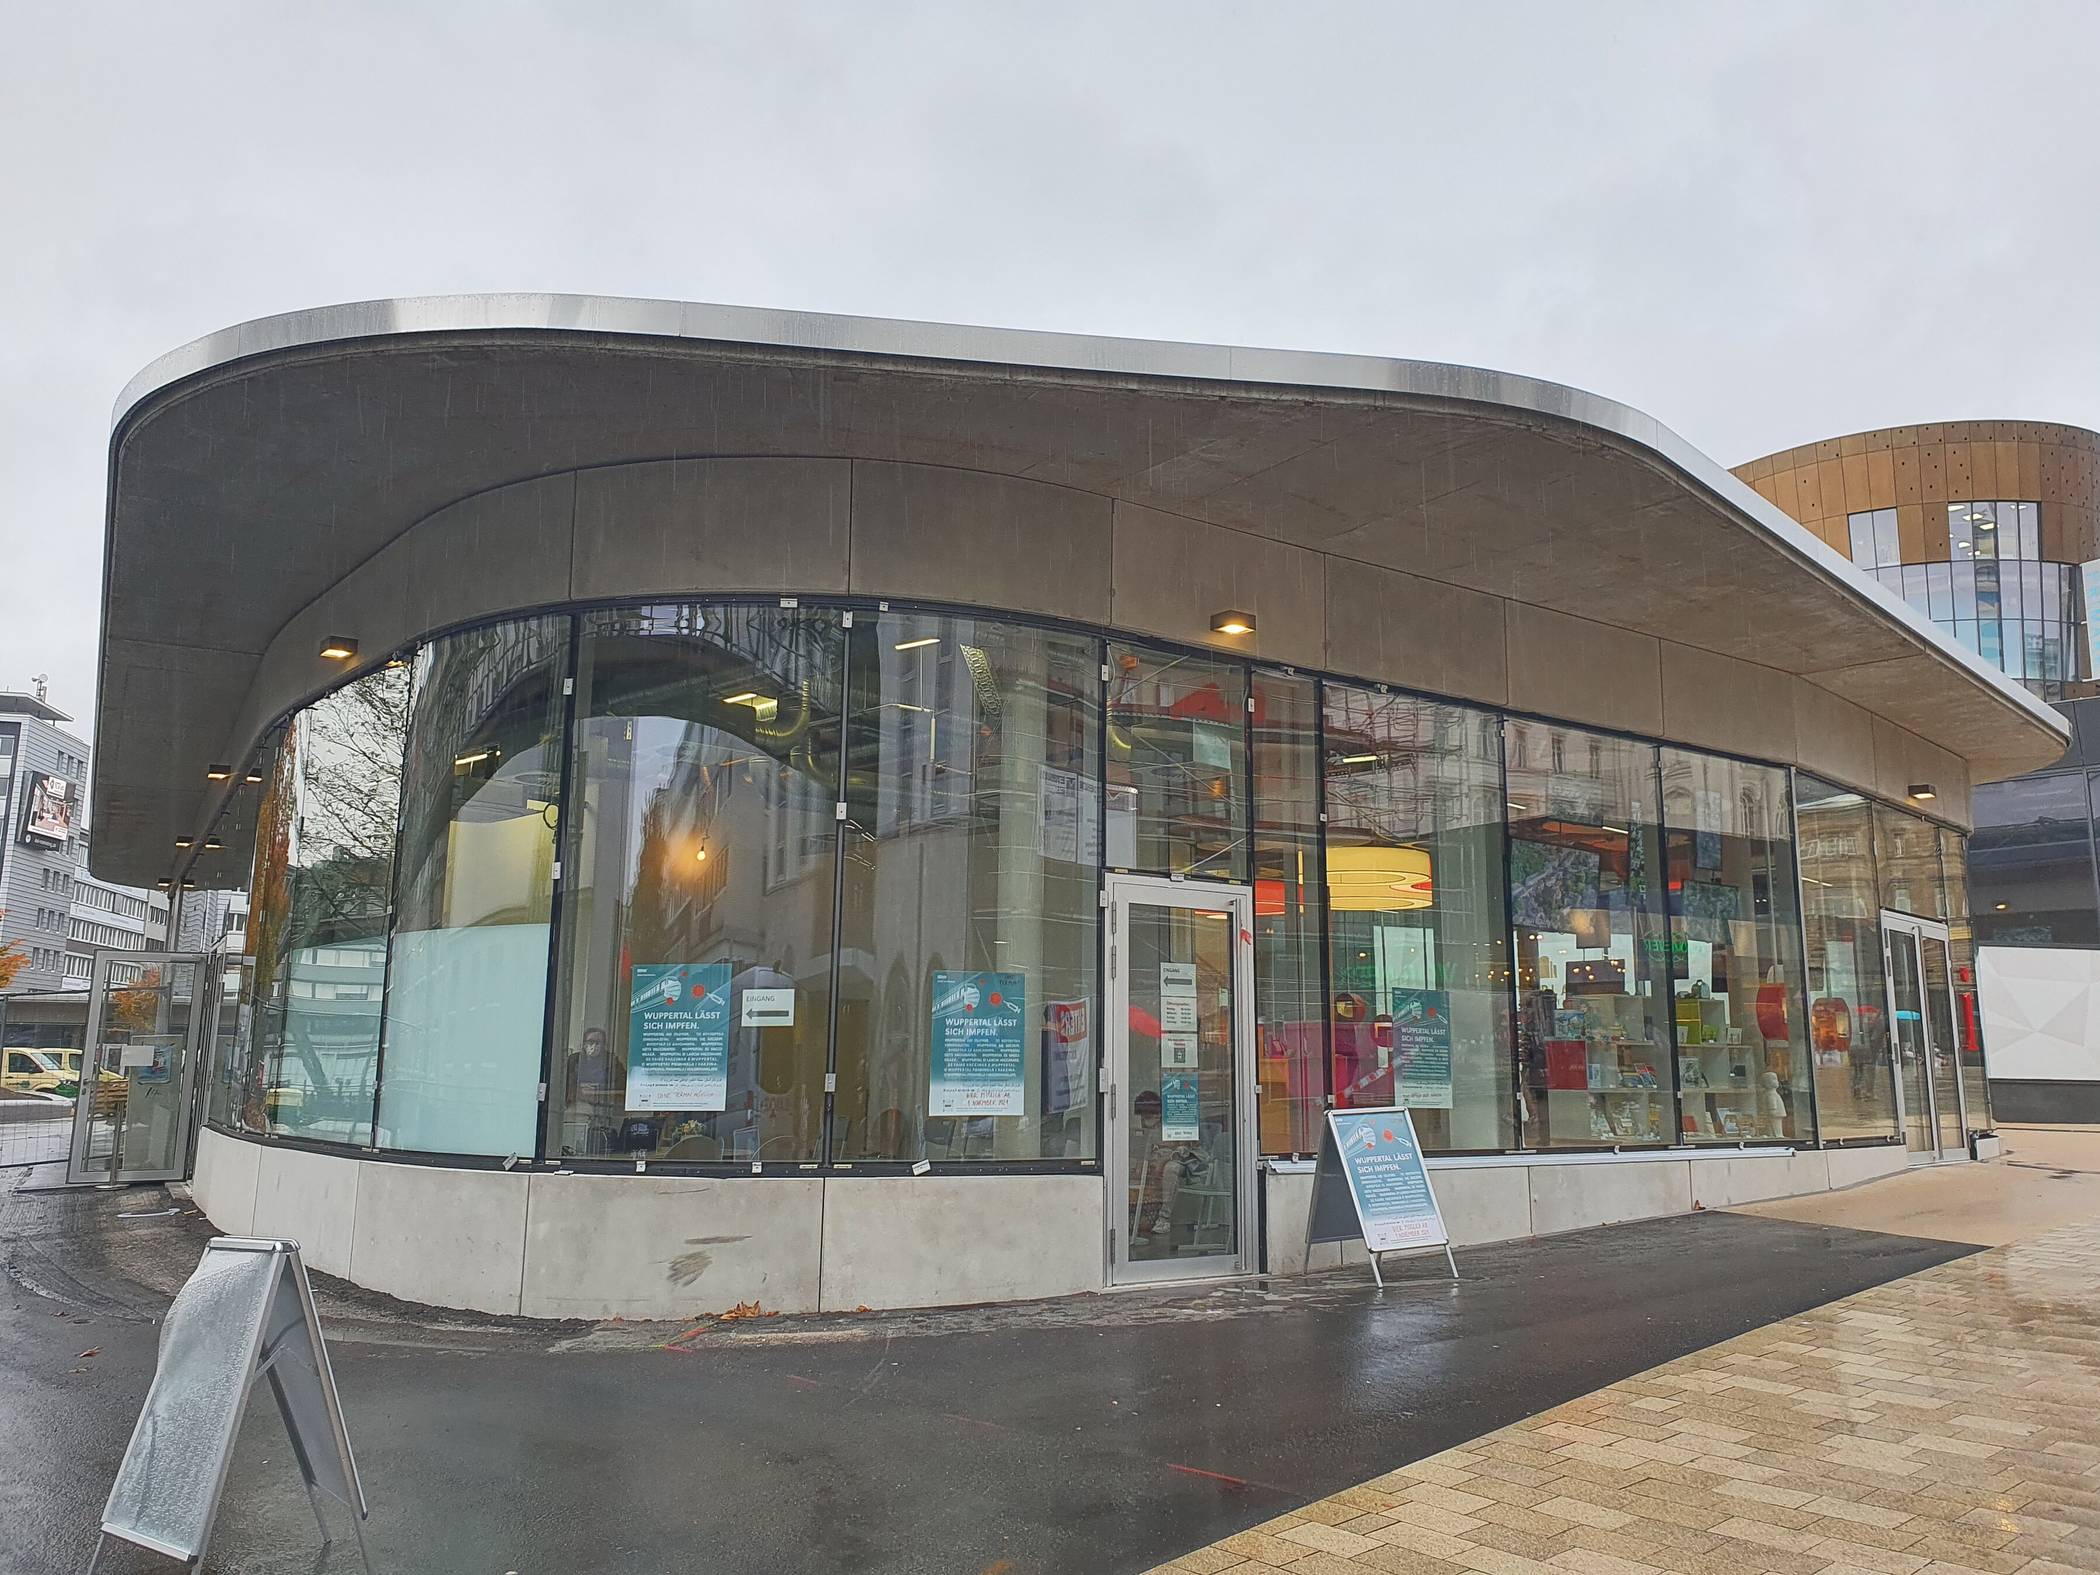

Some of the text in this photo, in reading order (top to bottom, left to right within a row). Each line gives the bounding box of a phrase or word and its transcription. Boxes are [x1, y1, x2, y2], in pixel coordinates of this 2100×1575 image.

[644, 1010, 720, 1020] WUPPERTAL LÄSST
[644, 1021, 699, 1029] SICH IMPFEN.
[945, 1017, 1017, 1026] WUPPERTAL LÄSST
[966, 1028, 998, 1036] IMPFEN.
[1355, 1153, 1412, 1164] WUPPERTAL LÄSST
[1374, 1164, 1401, 1172] IMPFEN.
